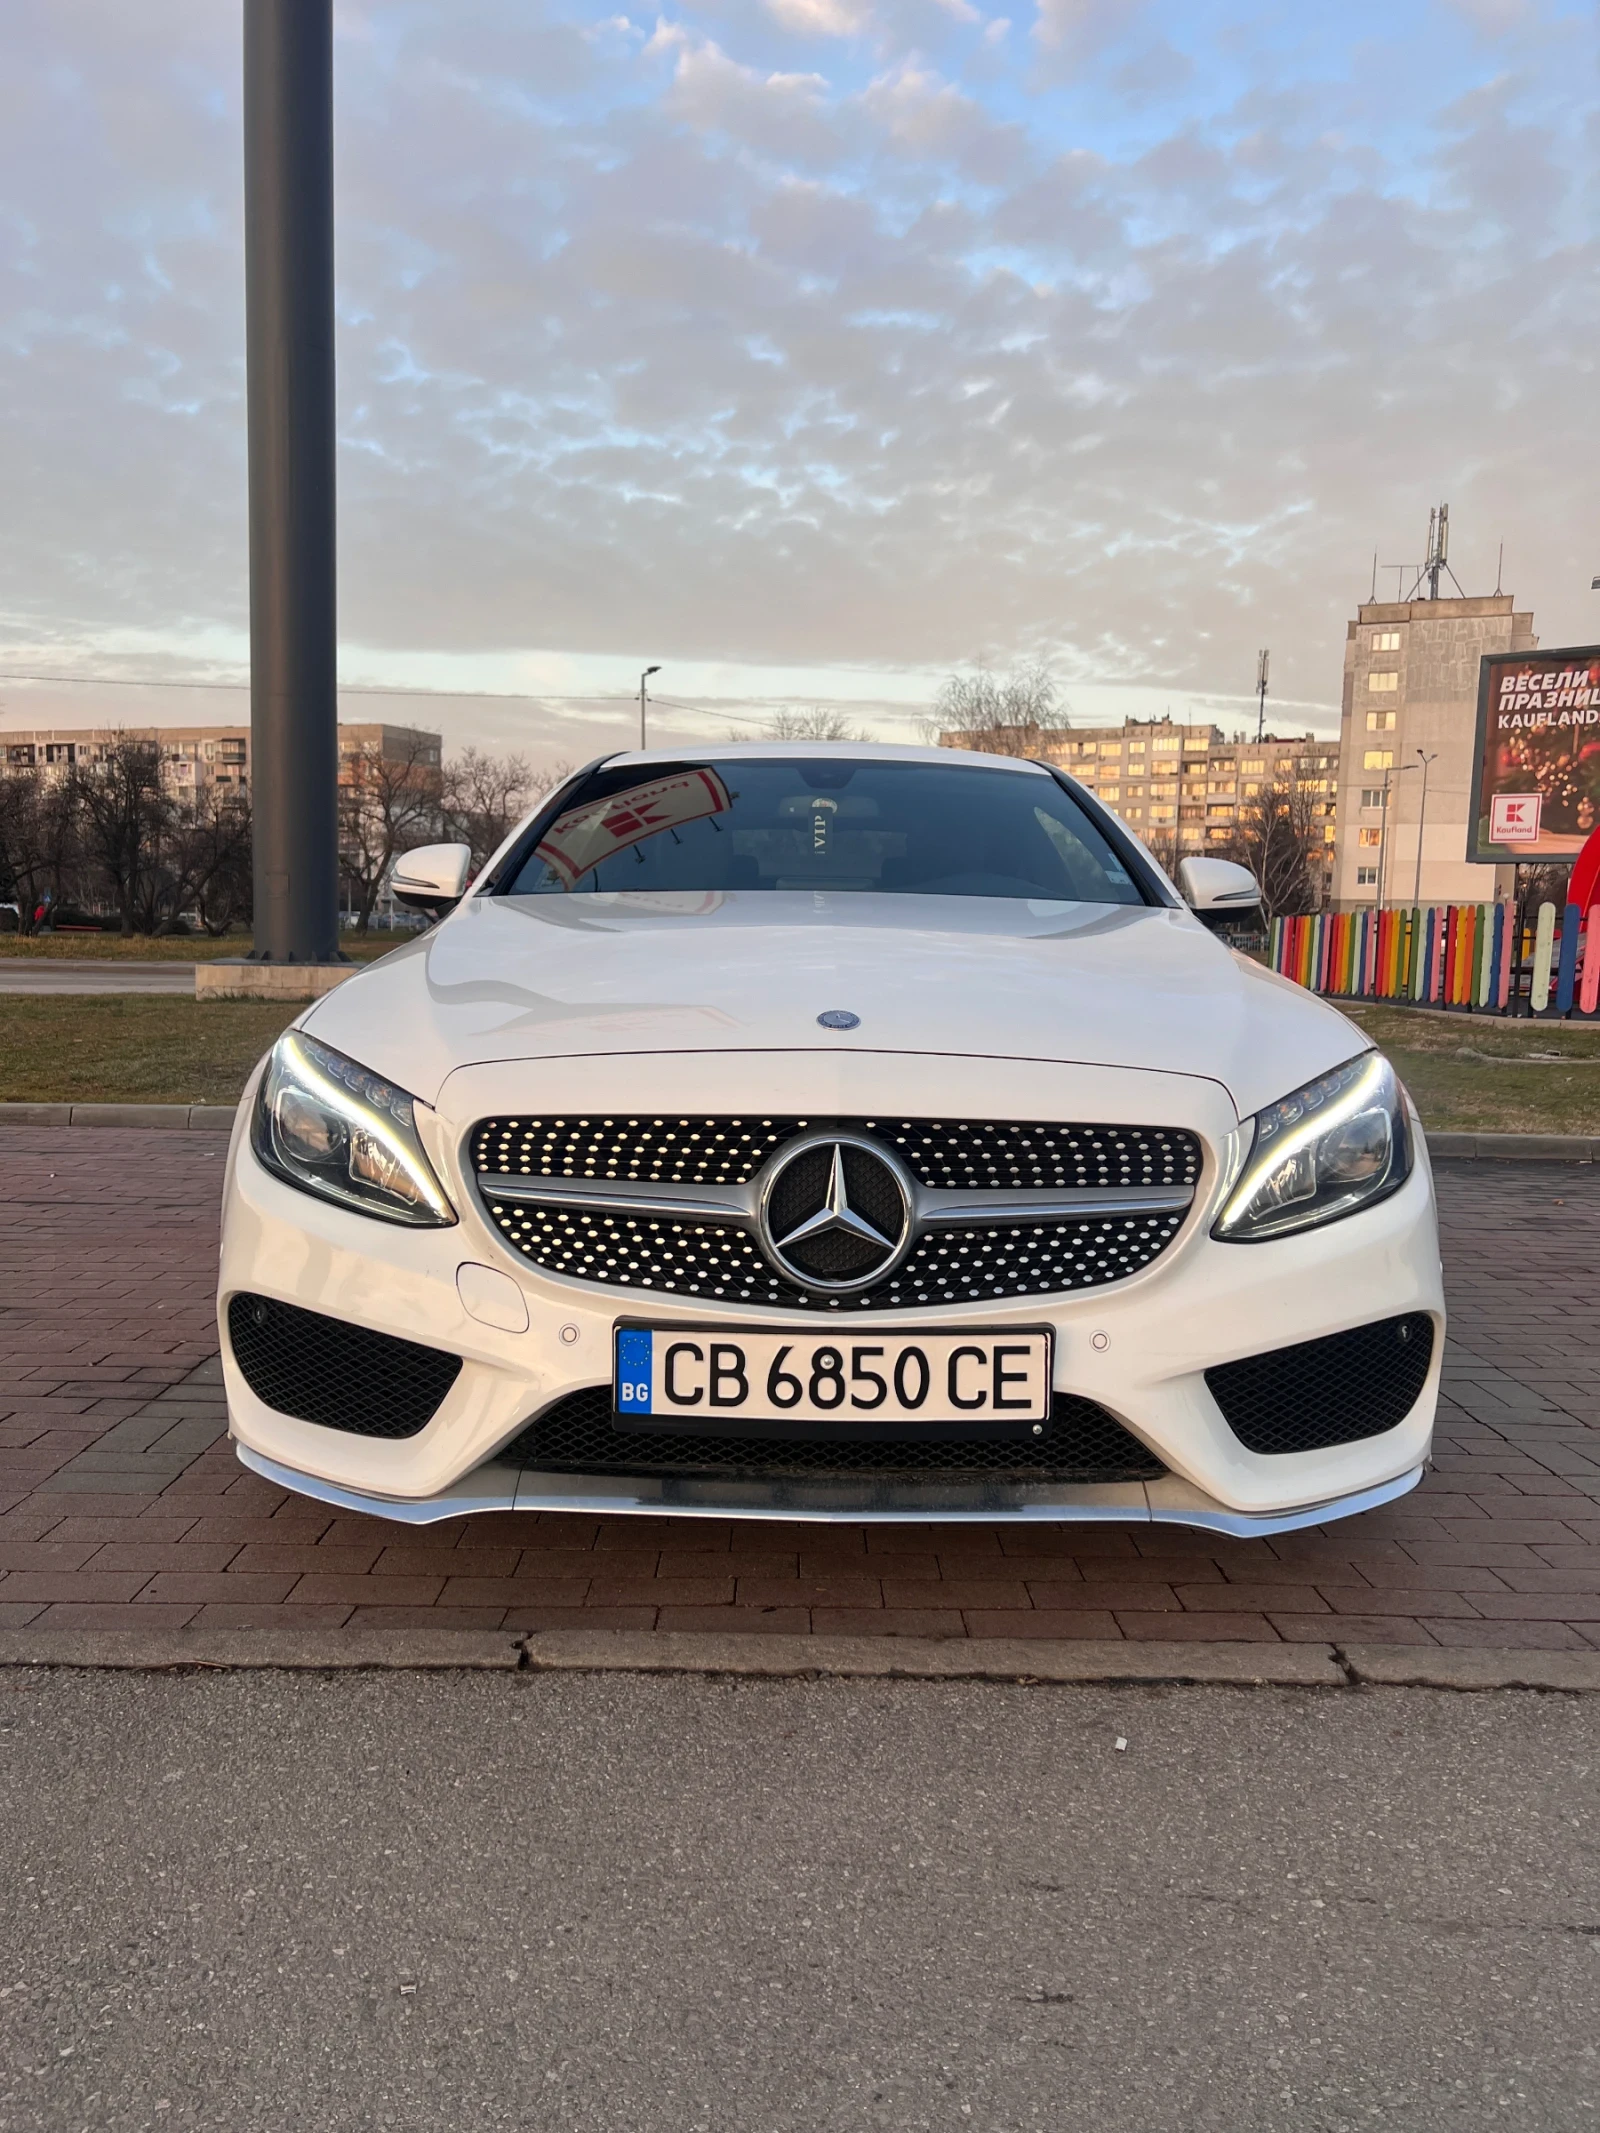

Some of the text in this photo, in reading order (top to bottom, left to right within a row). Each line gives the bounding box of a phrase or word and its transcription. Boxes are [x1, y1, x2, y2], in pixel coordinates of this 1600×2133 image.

[1500, 670, 1590, 693] ВЕСЕЛИ
[814, 815, 825, 848] VIP
[1496, 825, 1532, 834] Kaufland
[664, 1342, 1032, 1410] CB 6850 CE
[621, 1382, 649, 1402] BG
